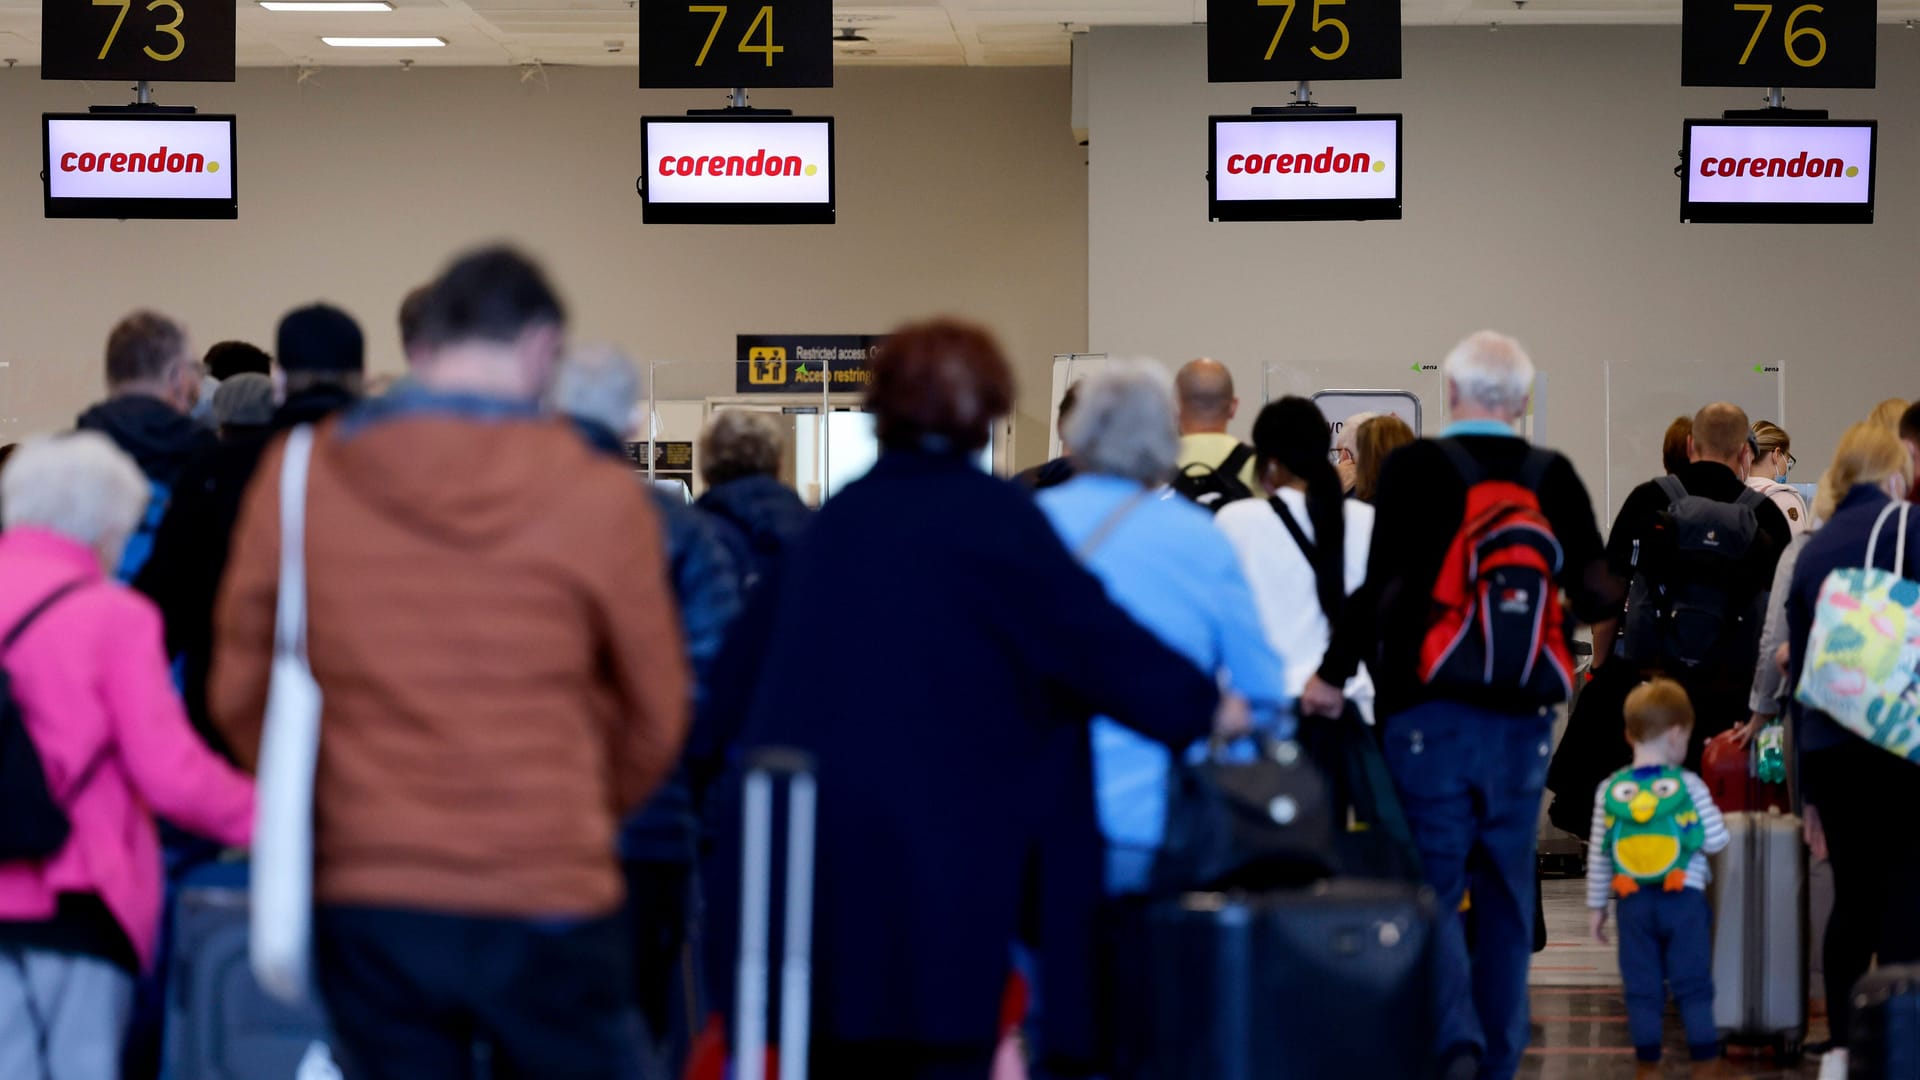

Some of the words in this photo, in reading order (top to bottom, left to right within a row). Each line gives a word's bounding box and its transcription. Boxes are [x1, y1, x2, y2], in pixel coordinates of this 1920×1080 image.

[92, 0, 185, 62] 73
[688, 5, 784, 67] 74
[1257, 0, 1350, 61] 75
[1734, 4, 1827, 67] 76
[796, 346, 837, 360] Restricted
[833, 367, 875, 385] restring
